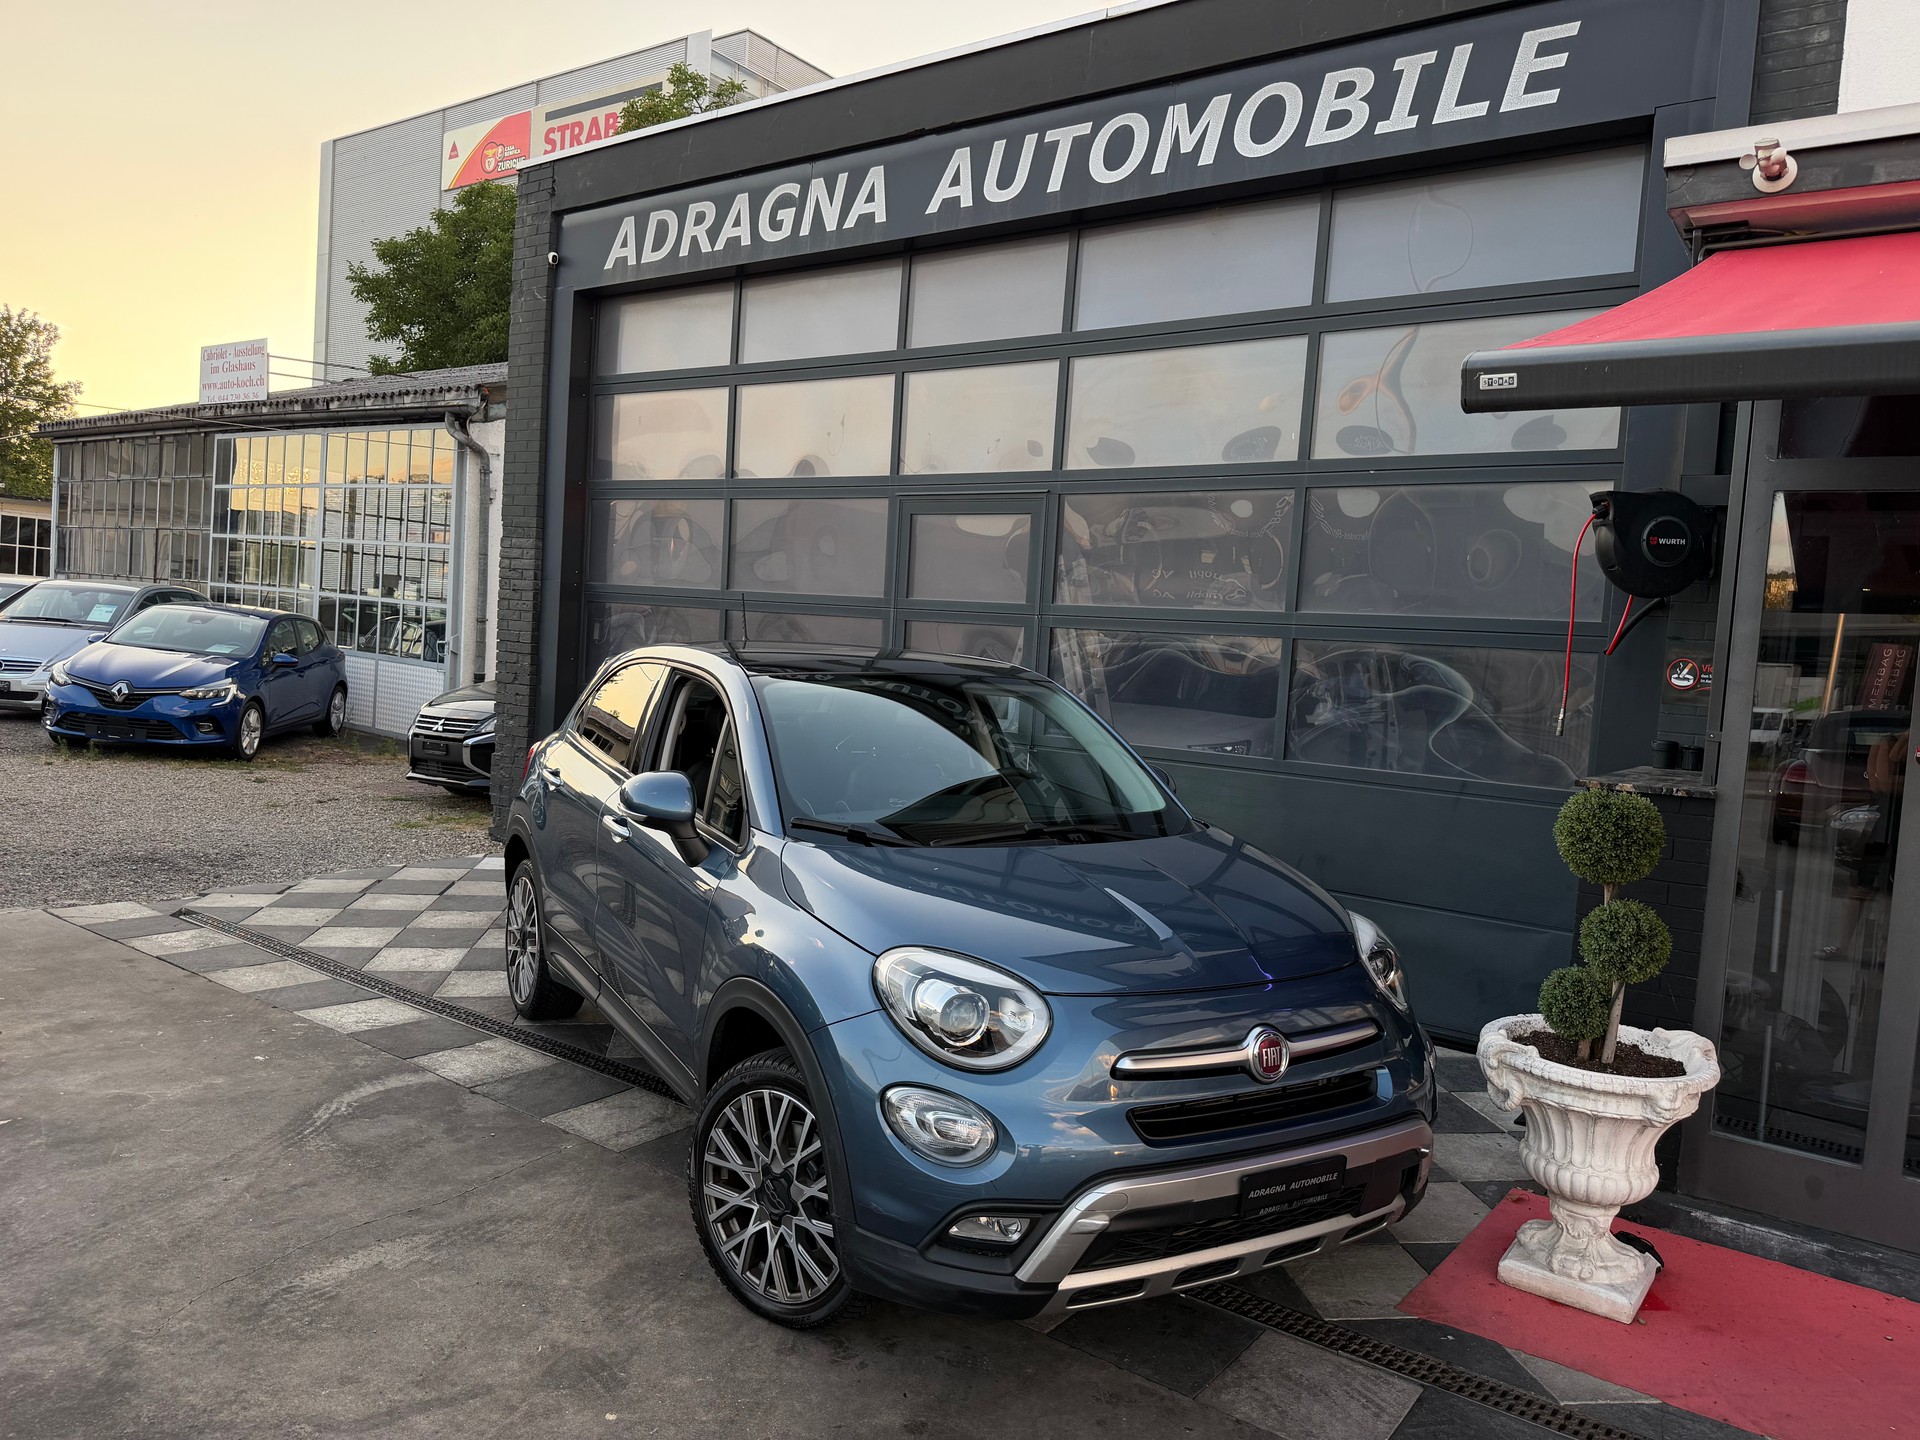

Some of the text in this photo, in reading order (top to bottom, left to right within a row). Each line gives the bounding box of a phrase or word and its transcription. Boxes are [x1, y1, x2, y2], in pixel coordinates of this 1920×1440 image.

[604, 21, 1581, 270] ADRAGNA AUTOMOBILE
[203, 348, 227, 361] Cabriolet
[233, 344, 265, 358] Ausstellung
[211, 360, 256, 374] im Glashaus
[202, 375, 265, 391] www.auto-koch.ch
[1483, 377, 1514, 386] STOBAG
[1868, 648, 1893, 708] MERBAG
[1262, 1045, 1281, 1068] FIAT
[1248, 1172, 1339, 1199] ADRAGNA AUTOMOBILE
